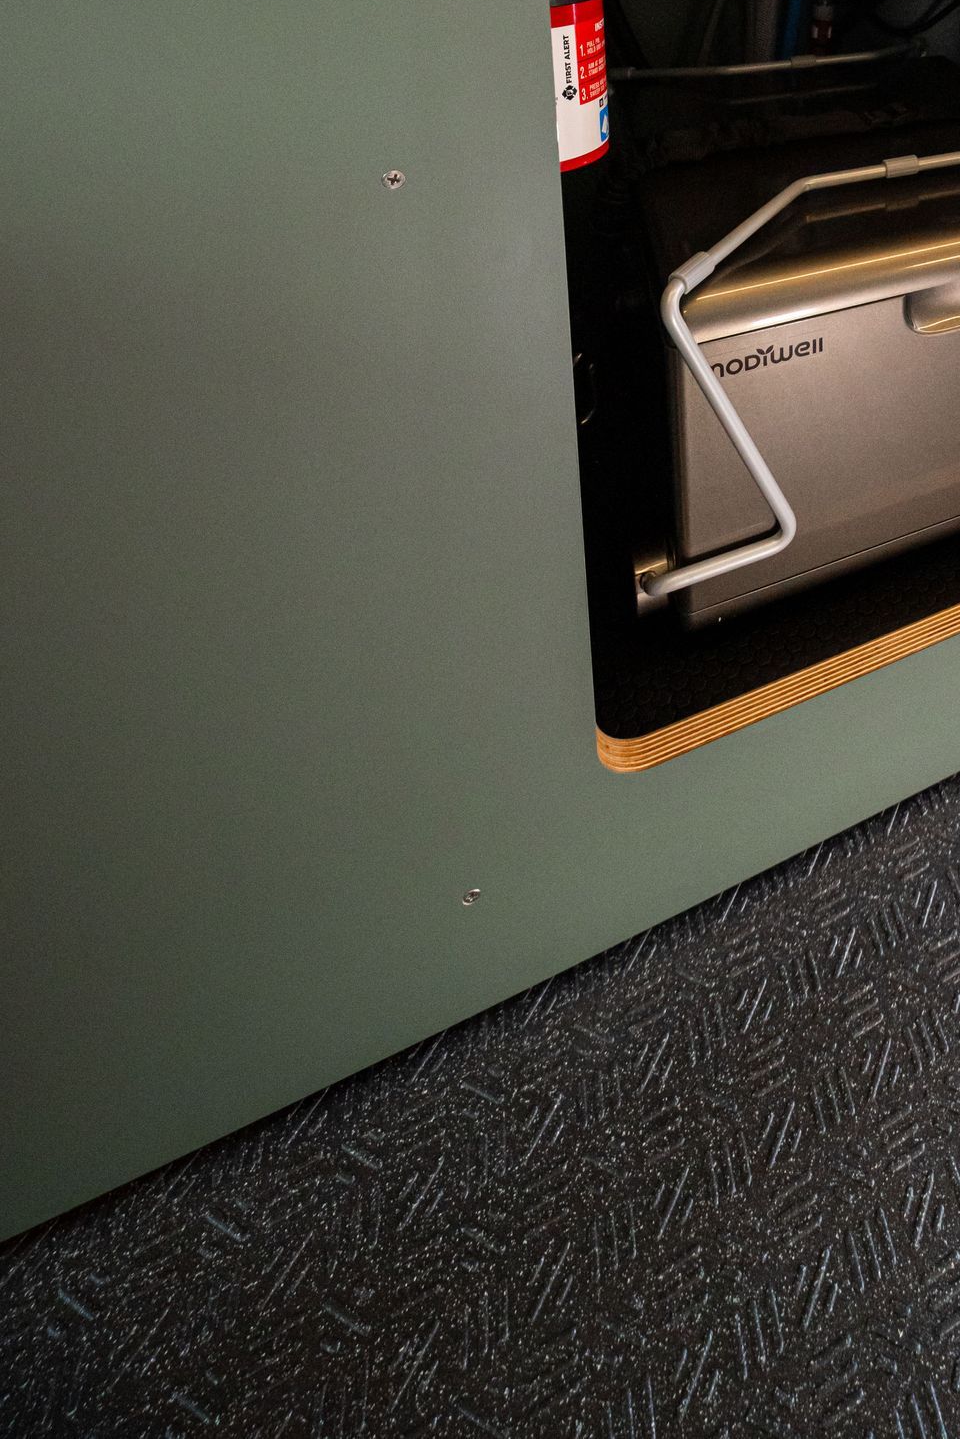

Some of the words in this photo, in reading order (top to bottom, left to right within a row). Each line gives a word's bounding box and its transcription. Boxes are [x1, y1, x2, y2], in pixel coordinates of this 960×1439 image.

[580, 44, 586, 57] 1.
[580, 66, 587, 79] 2.
[582, 88, 588, 101] 3.
